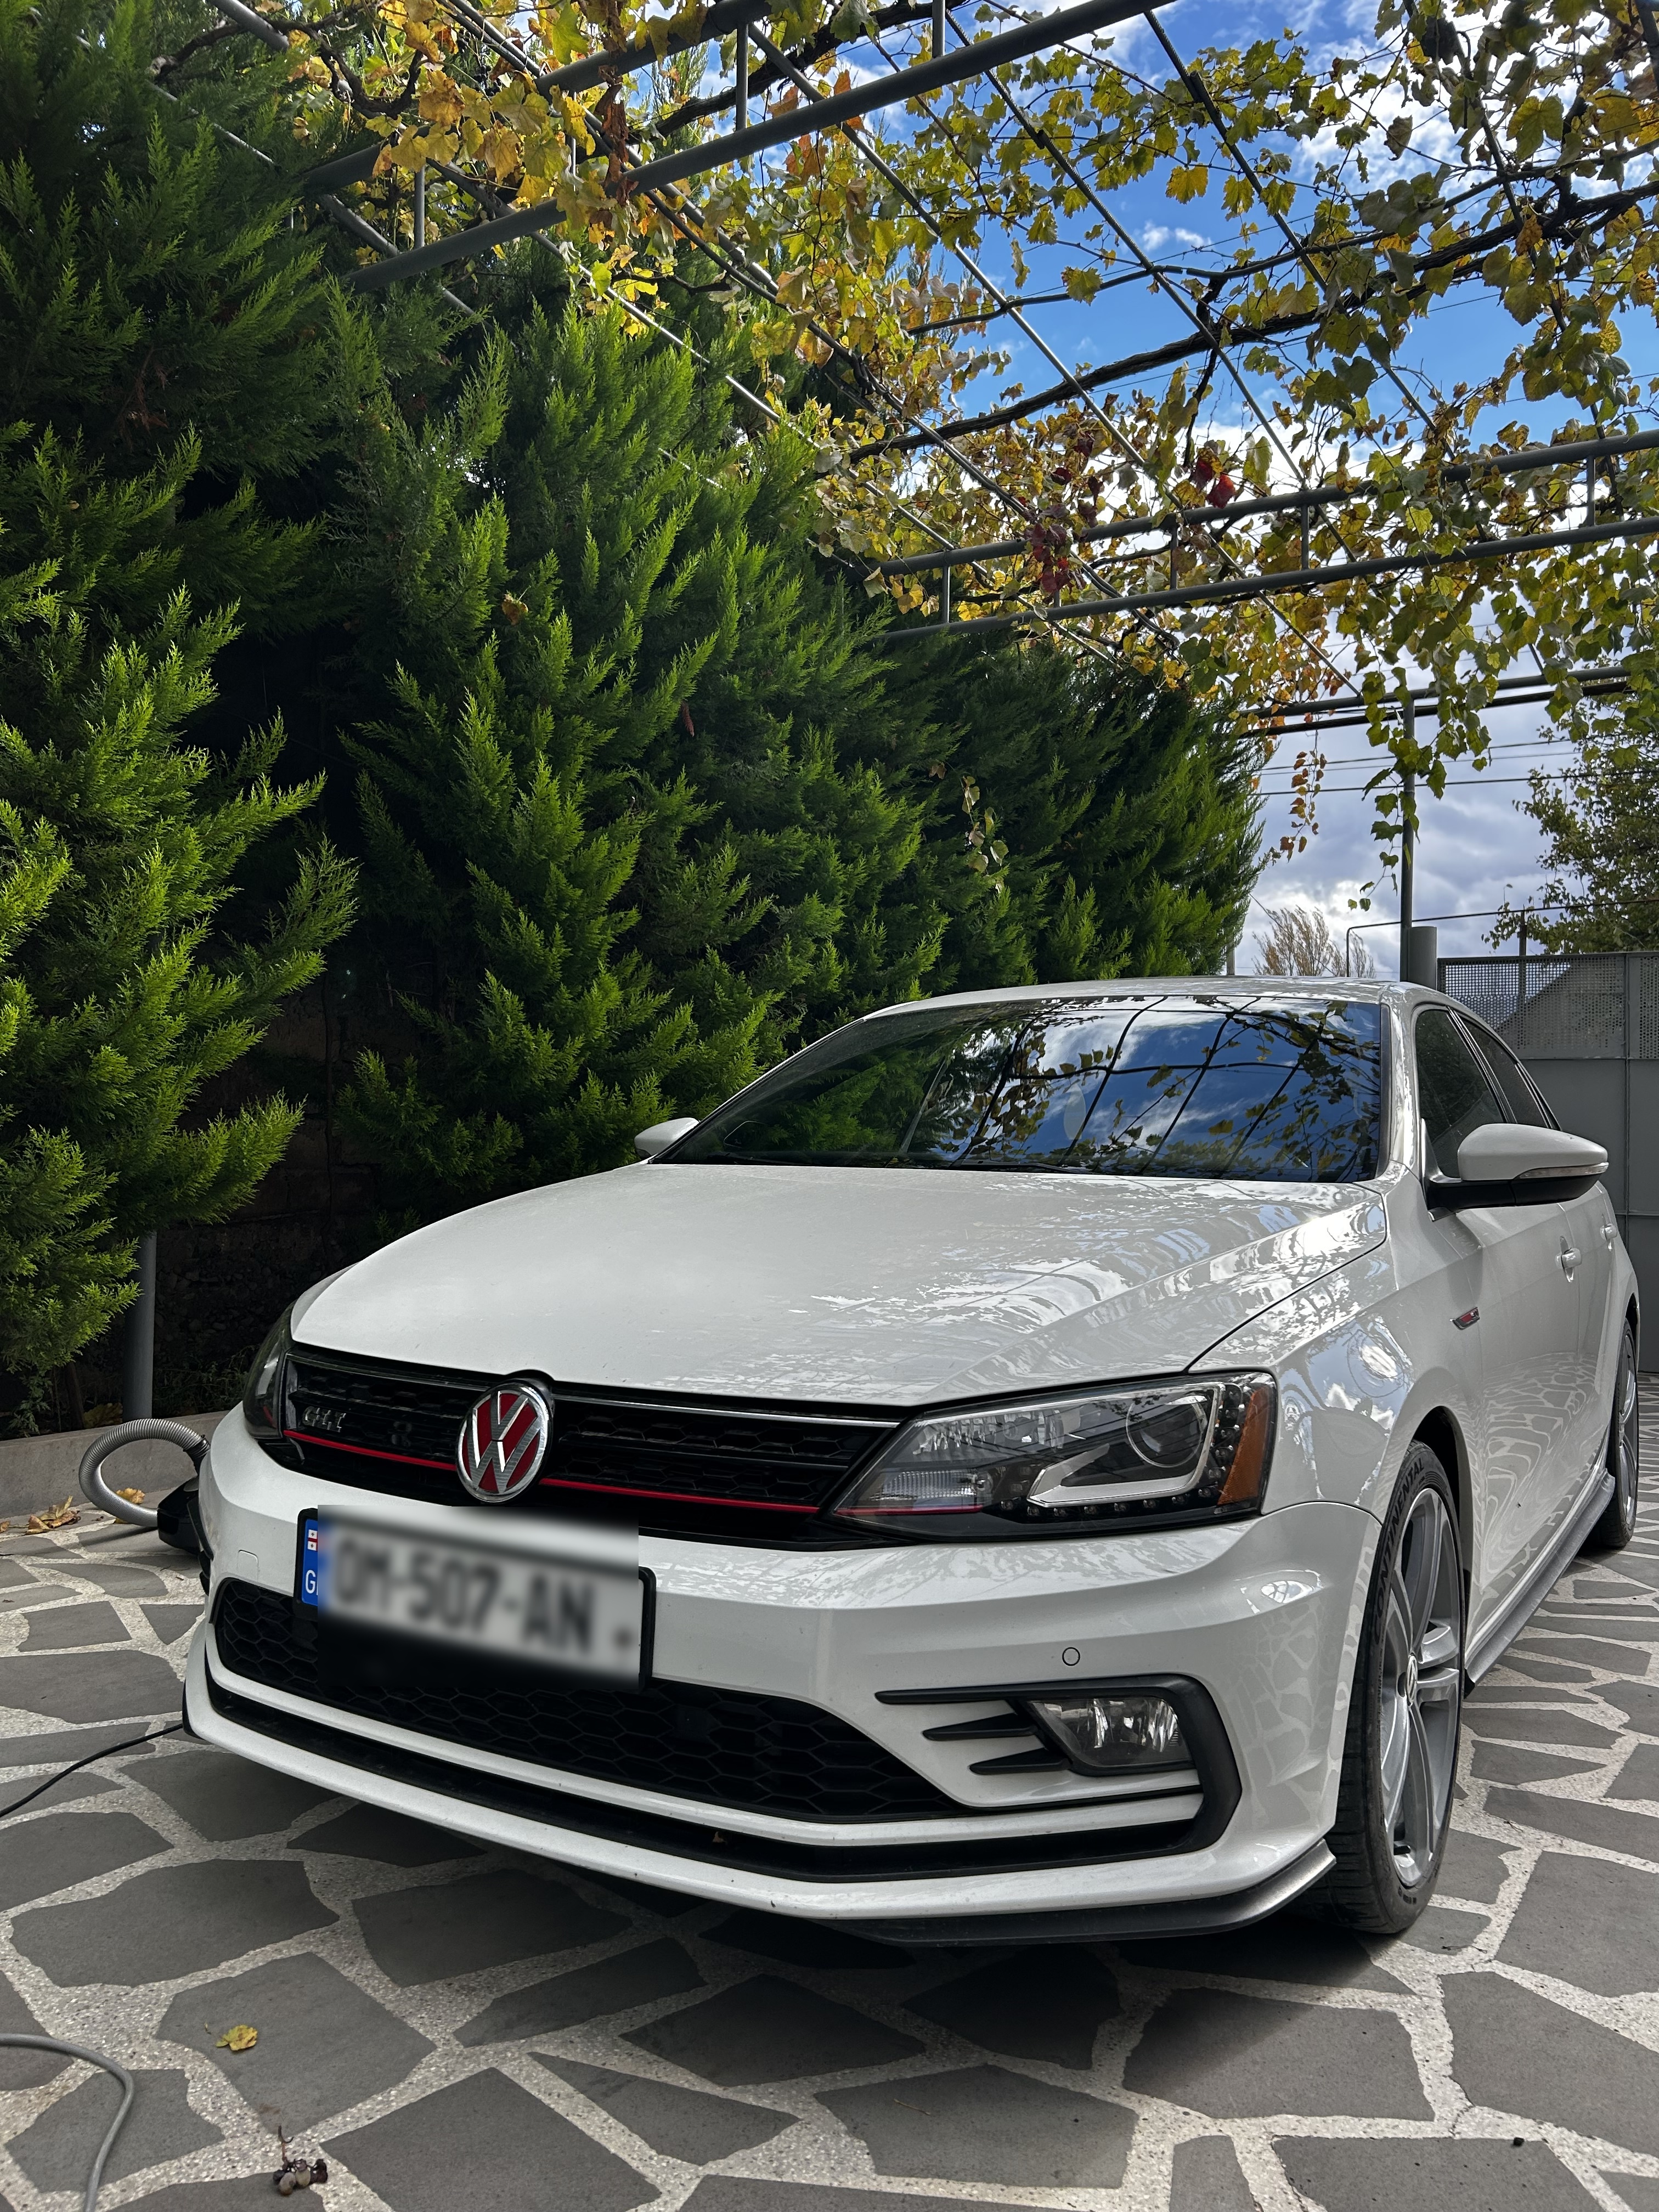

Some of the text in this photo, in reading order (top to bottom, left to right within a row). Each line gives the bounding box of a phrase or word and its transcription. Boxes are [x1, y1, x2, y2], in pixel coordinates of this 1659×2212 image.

[460, 1390, 541, 1494] VW
[306, 1570, 318, 1596] G
[1374, 1458, 1425, 1645] CONTINENTAL
